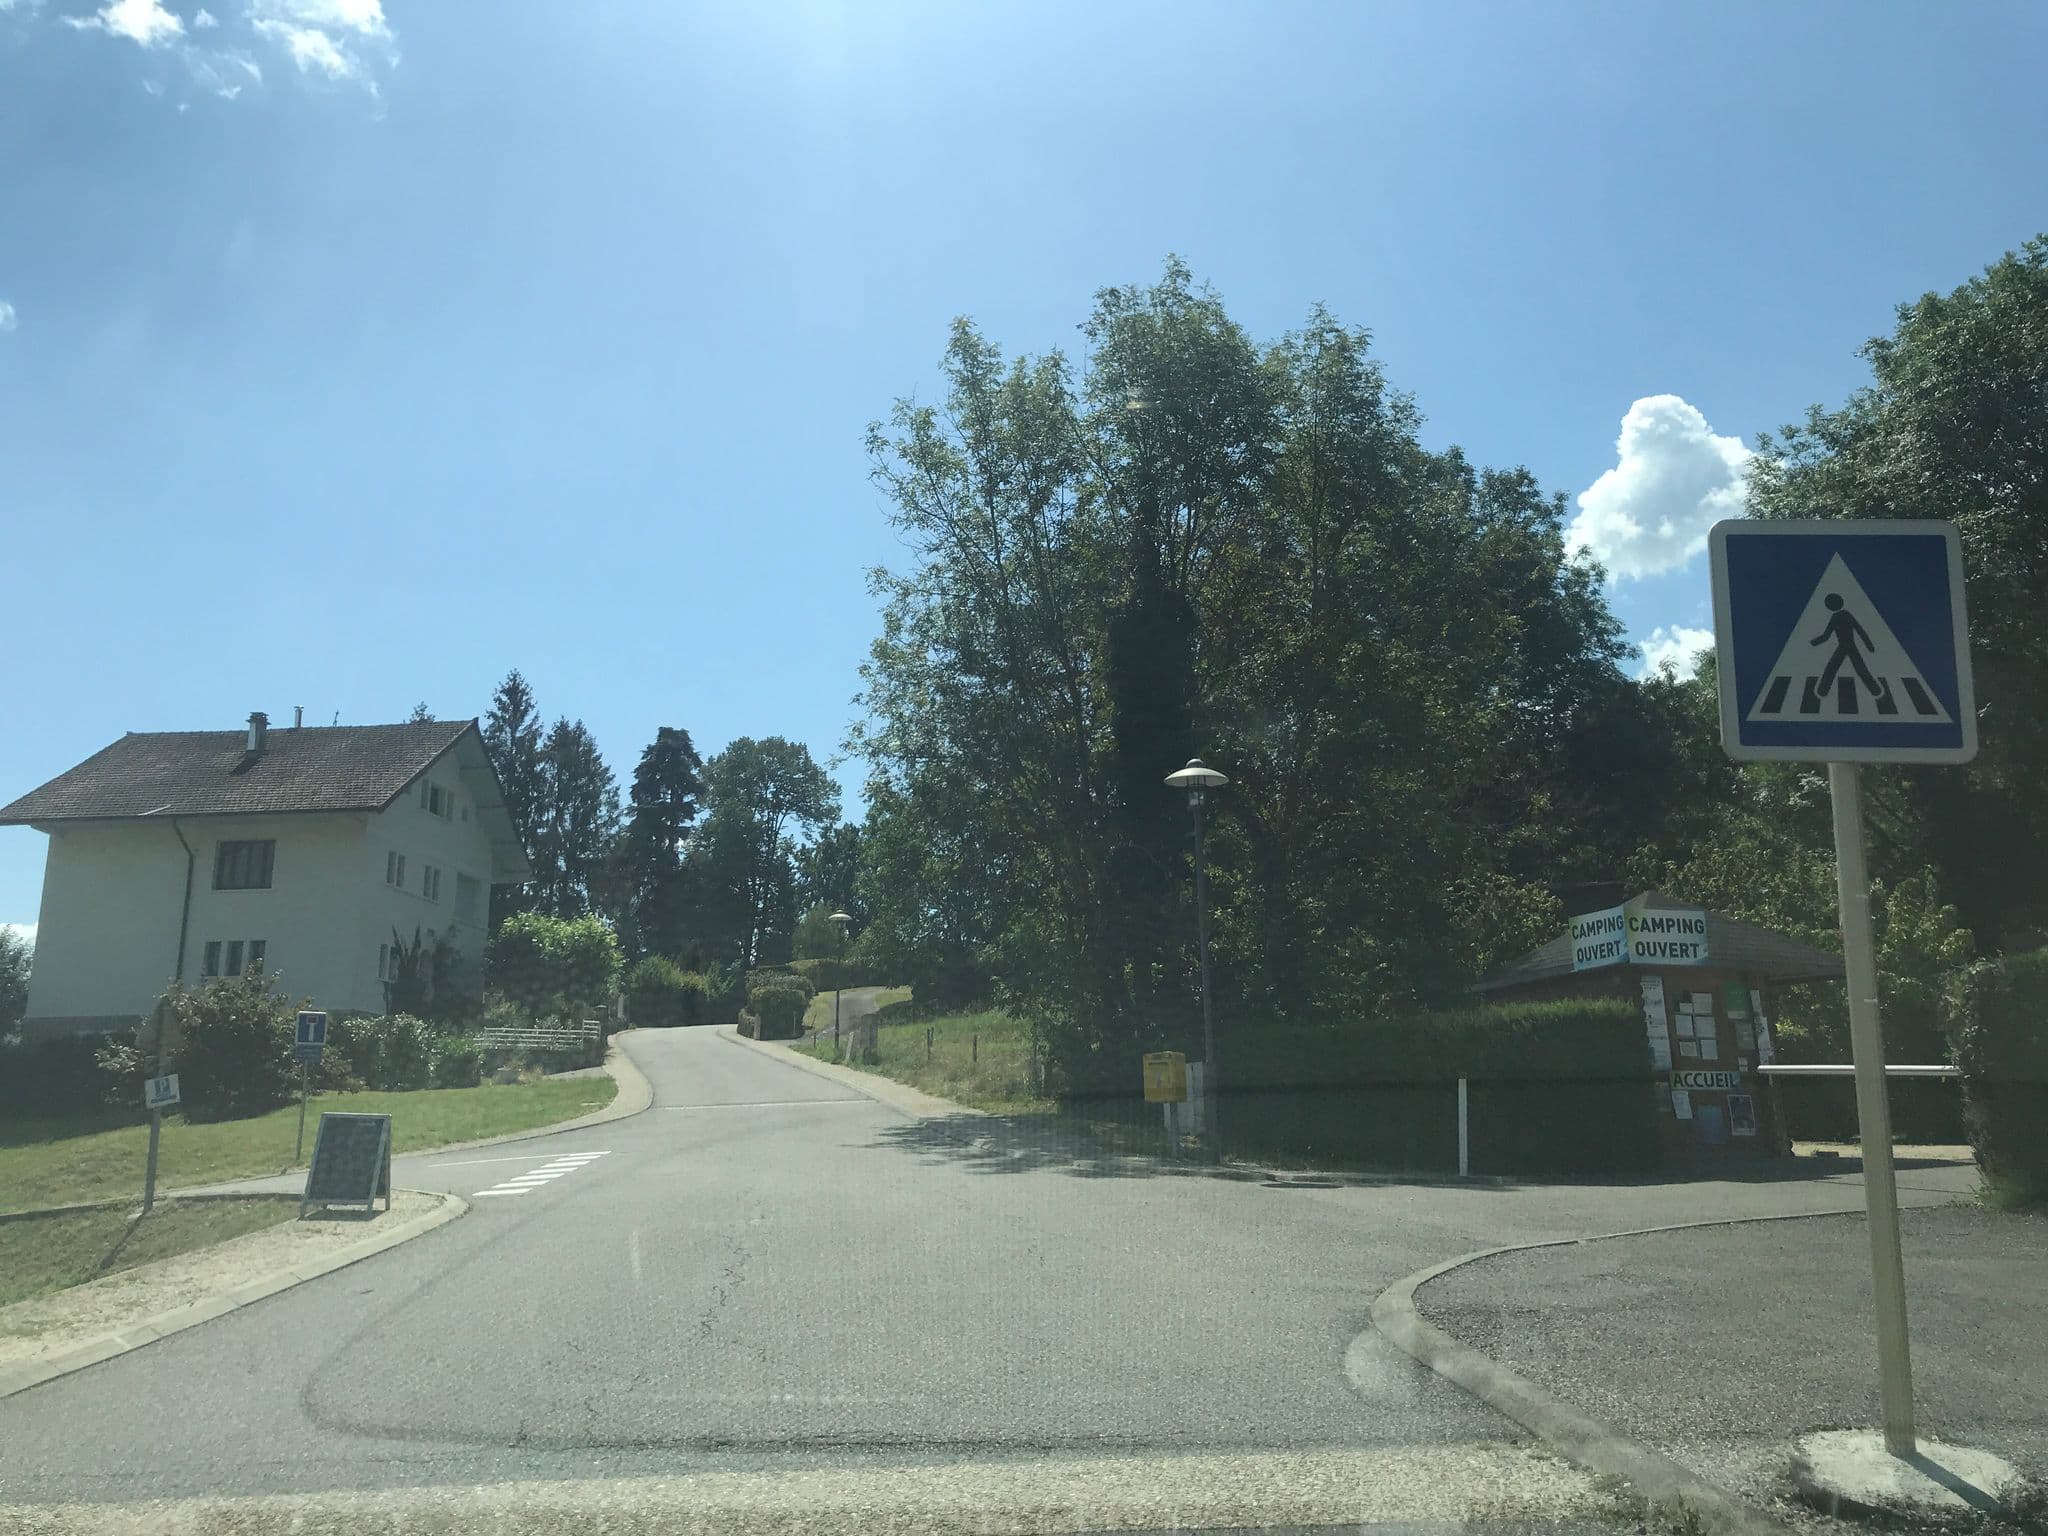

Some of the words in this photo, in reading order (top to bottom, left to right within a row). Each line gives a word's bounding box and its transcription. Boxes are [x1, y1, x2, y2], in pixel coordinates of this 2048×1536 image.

[1572, 915, 1624, 940] CAMPING
[1629, 917, 1705, 934] CAMPING
[1577, 940, 1620, 963] OUVERT
[1635, 941, 1700, 958] OUVERT
[1673, 1072, 1737, 1088] ACCUEIL
